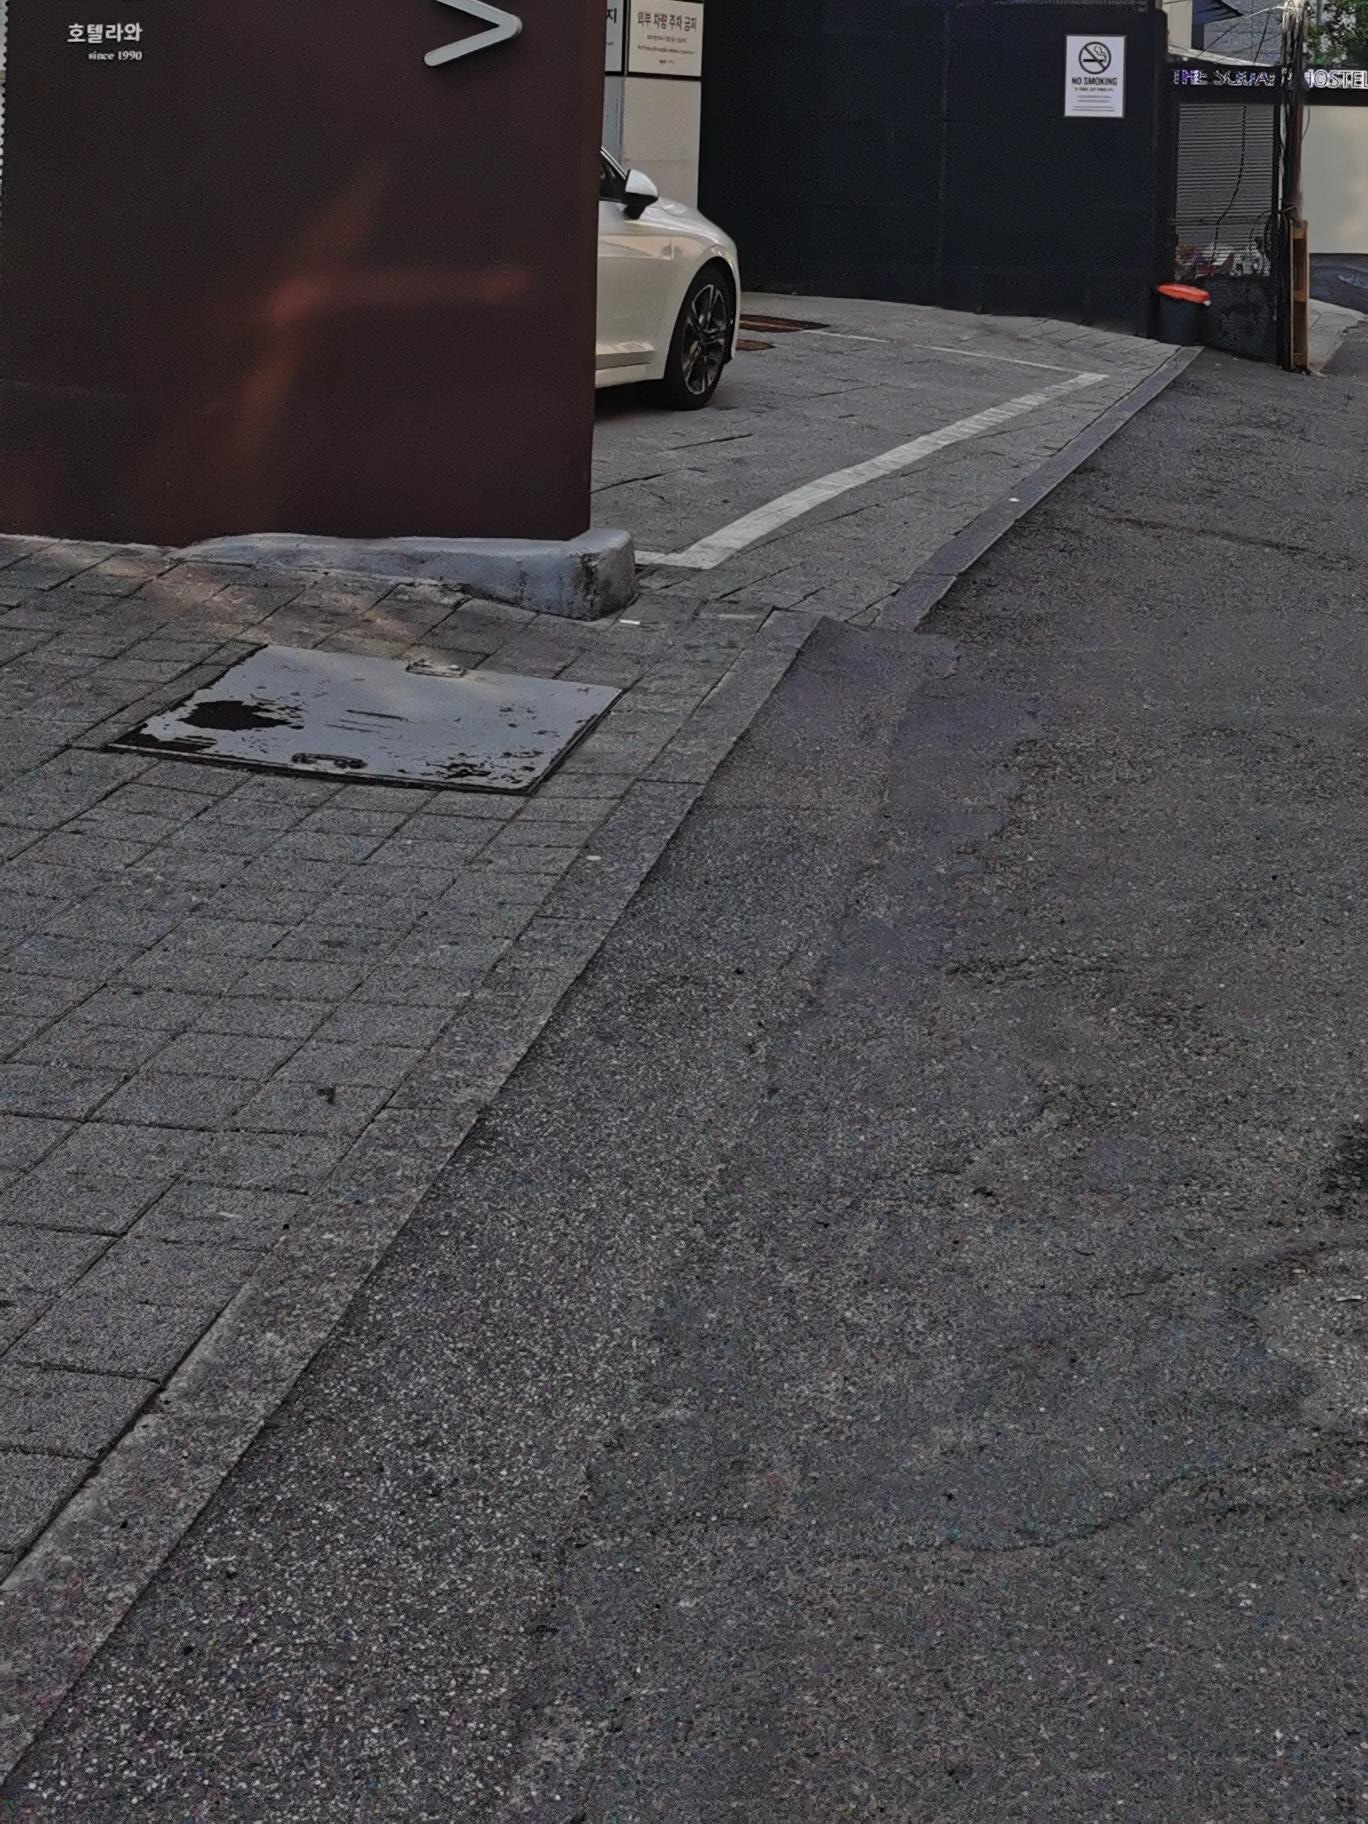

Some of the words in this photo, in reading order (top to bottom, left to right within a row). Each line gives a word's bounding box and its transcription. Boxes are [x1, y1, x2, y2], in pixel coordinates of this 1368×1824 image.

[637, 11, 651, 27] 외부
[669, 15, 682, 30] 주차
[684, 16, 697, 32] 금지
[67, 22, 143, 44] 호텔라와
[88, 51, 114, 61] since
[117, 50, 143, 61] 1990
[1072, 77, 1082, 85] NO
[1084, 77, 1118, 86] SMOKING
